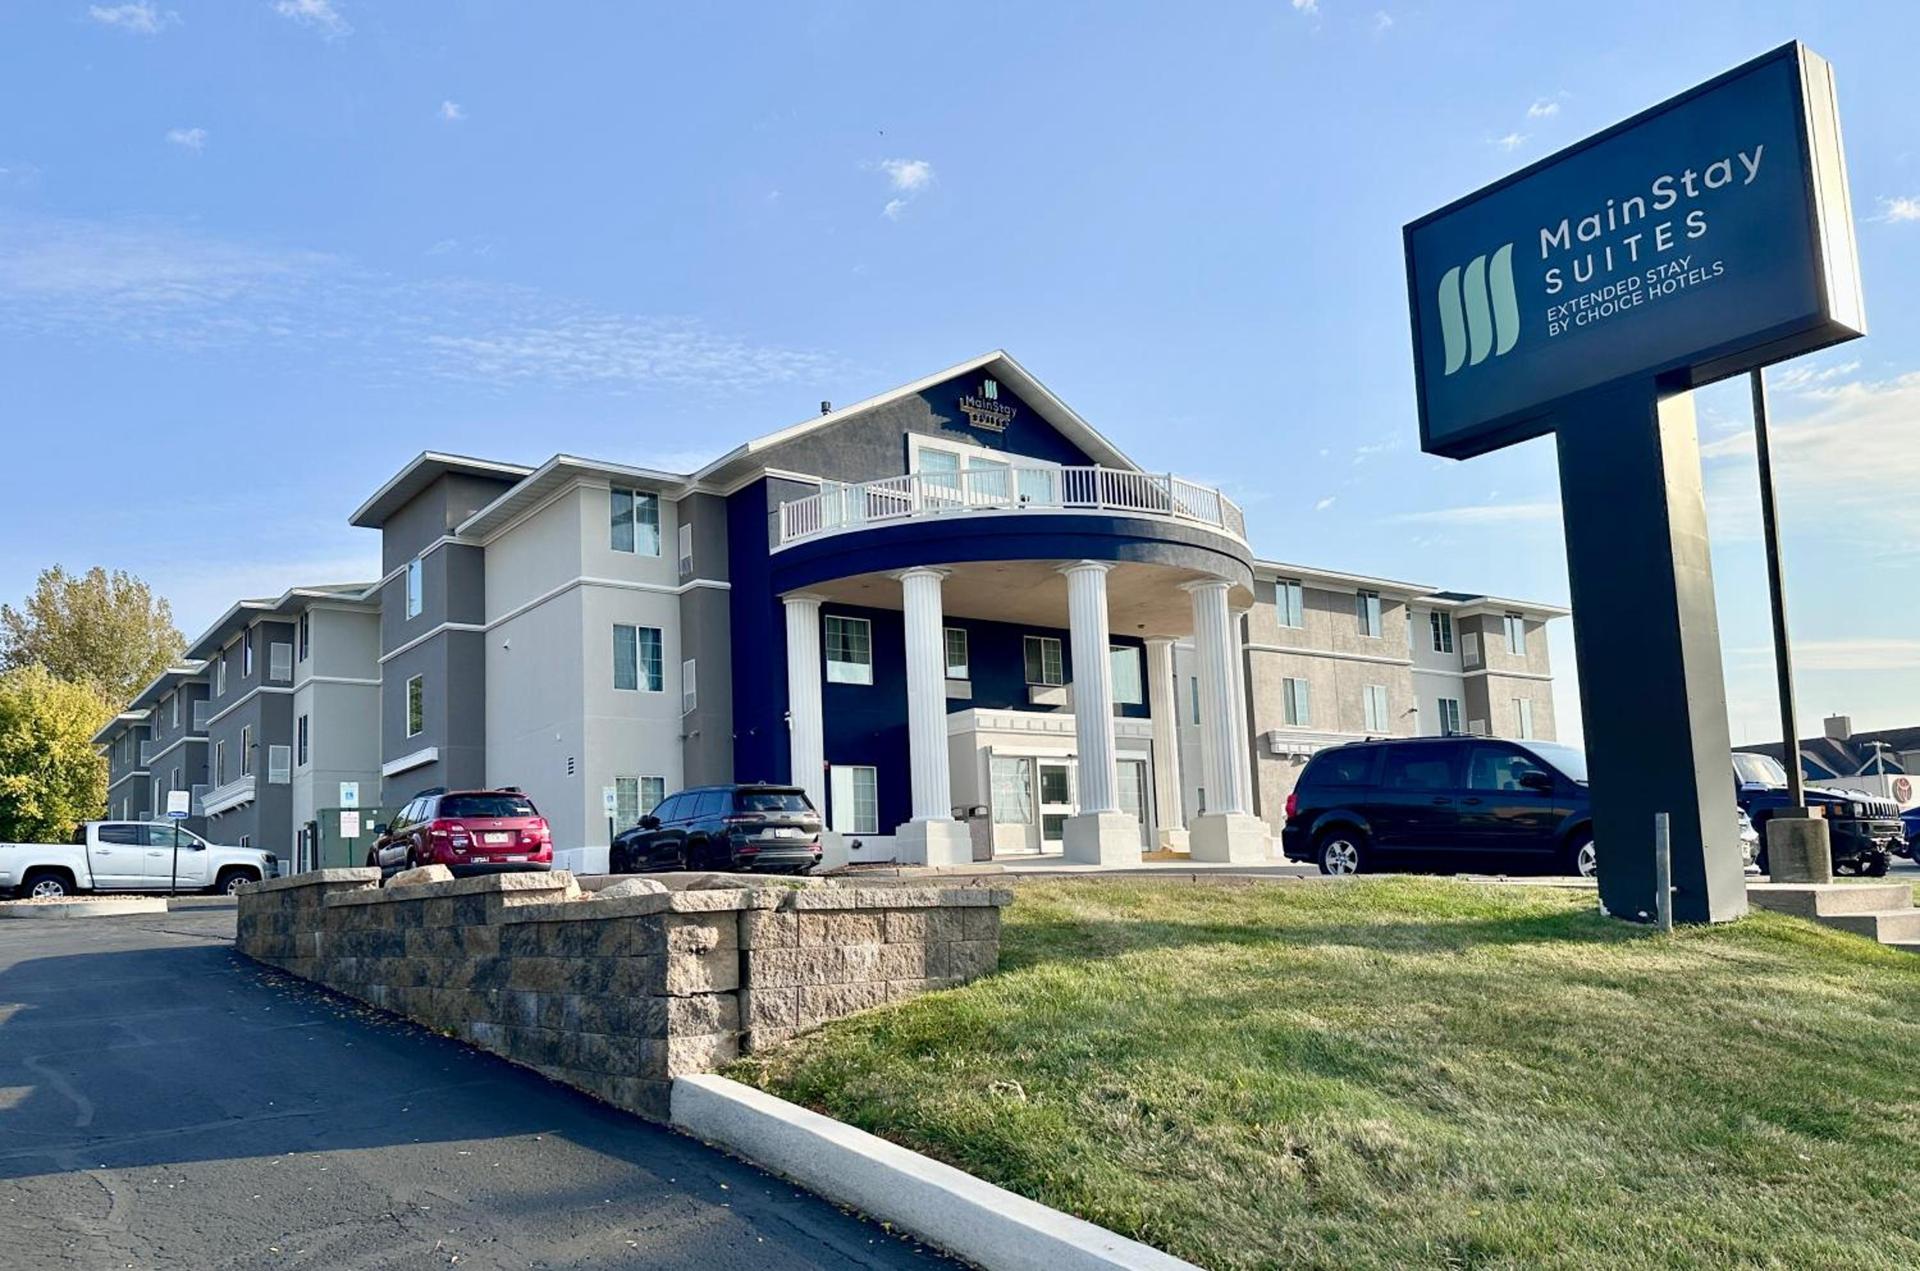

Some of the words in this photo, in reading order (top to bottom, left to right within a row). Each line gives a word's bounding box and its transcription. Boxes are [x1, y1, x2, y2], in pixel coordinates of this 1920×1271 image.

[1540, 144, 1764, 259] MainStay
[1546, 210, 1708, 294] SUITES
[1547, 276, 1641, 322] EXTENDED
[1646, 255, 1692, 284] STAY
[1549, 317, 1571, 337] BY
[1575, 294, 1643, 328] CHOICE
[1649, 260, 1725, 300] HOTELS
[965, 395, 1017, 418] MainStay
